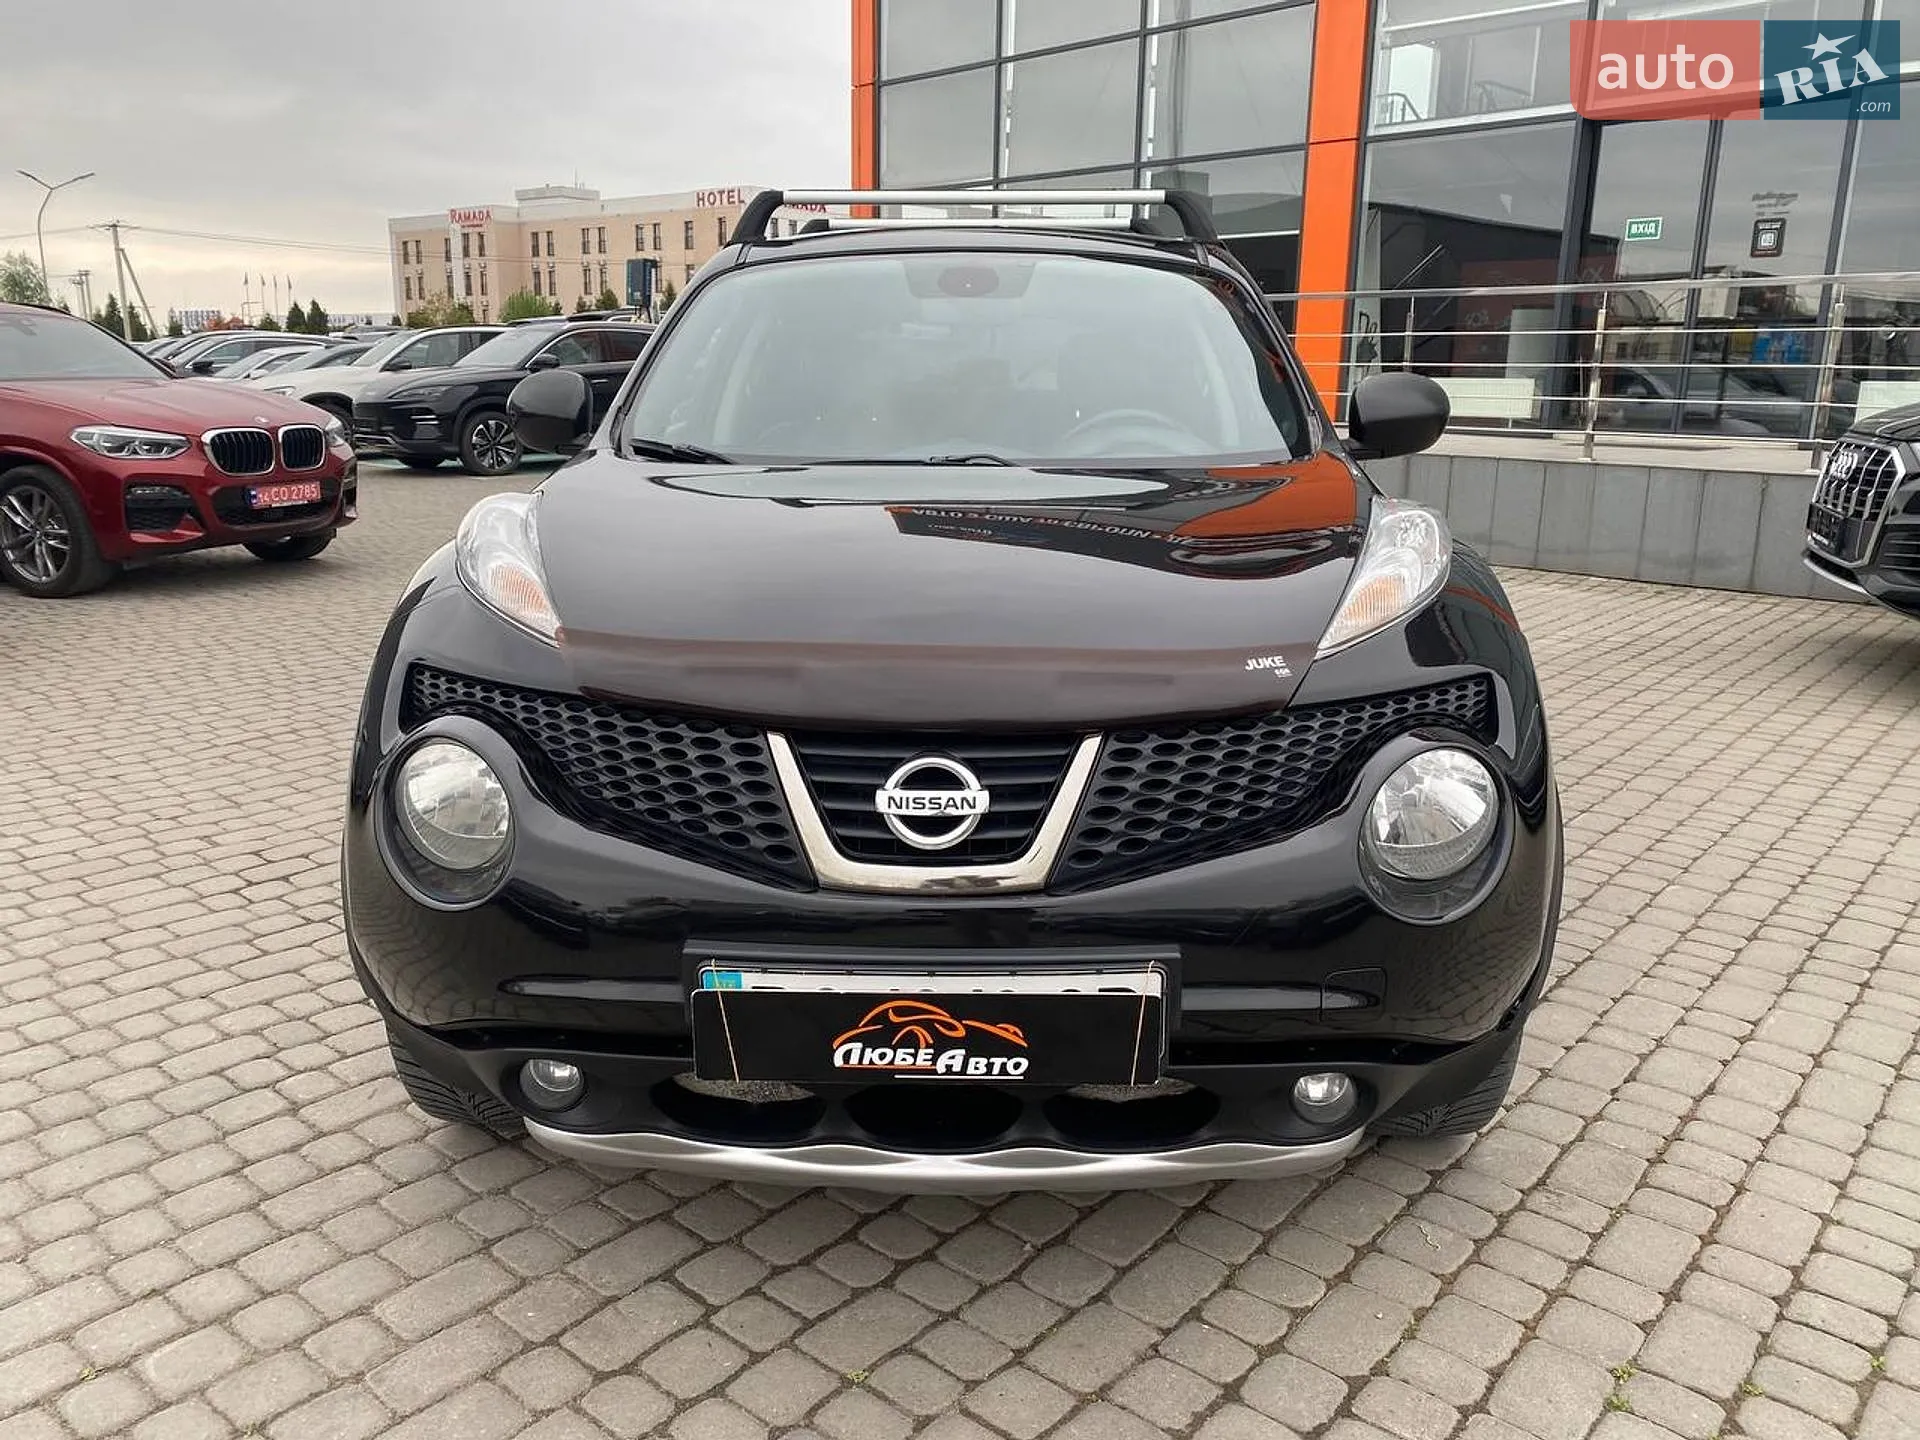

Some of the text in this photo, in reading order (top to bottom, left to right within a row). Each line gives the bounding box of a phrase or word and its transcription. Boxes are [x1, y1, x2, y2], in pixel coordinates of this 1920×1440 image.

[696, 188, 746, 207] HOTEL
[449, 208, 492, 224] RAMADA
[291, 483, 317, 499] 2785
[1245, 655, 1286, 670] JUKE
[887, 795, 977, 810] NISSAN
